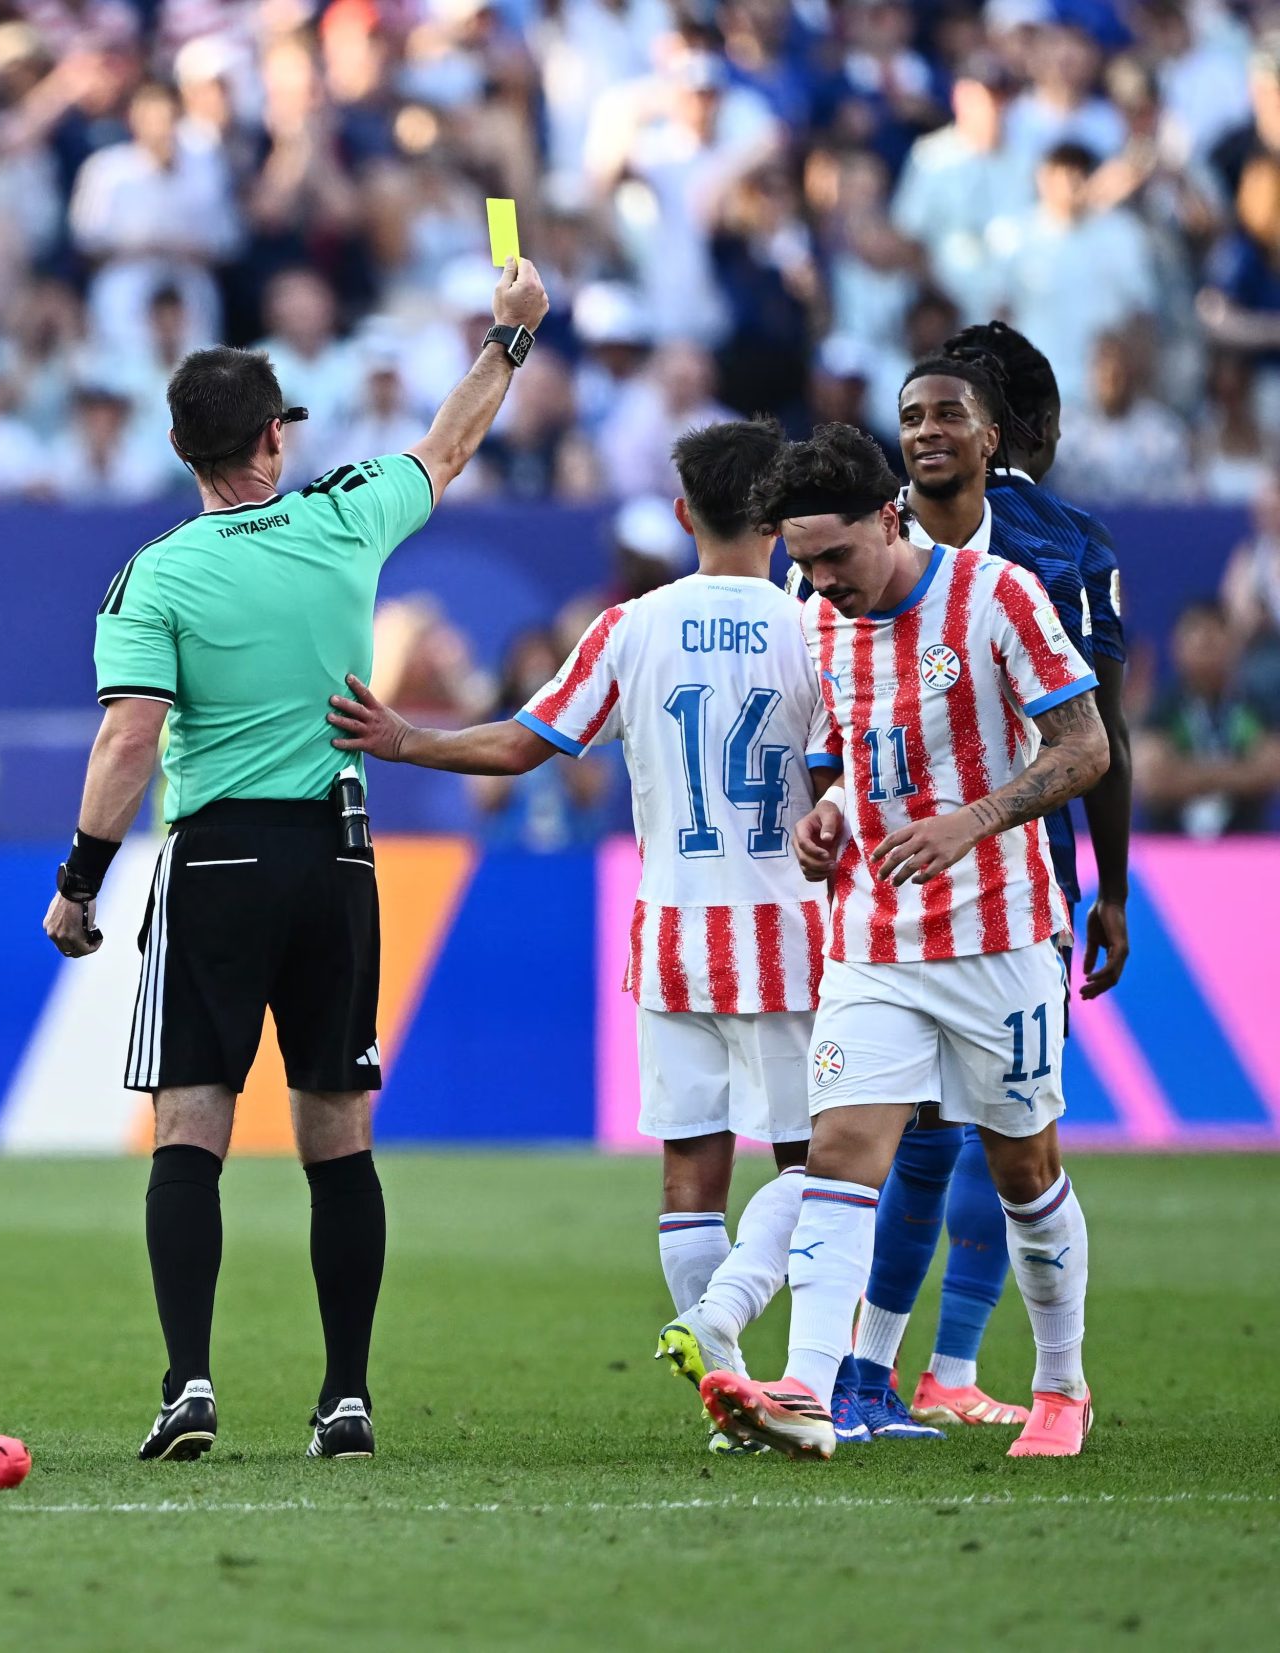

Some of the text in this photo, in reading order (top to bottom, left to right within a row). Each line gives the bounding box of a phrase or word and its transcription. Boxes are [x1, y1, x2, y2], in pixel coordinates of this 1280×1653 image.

[216, 513, 291, 539] TANTASHEV
[681, 617, 769, 655] CUBAS
[663, 683, 795, 860] 14
[862, 724, 919, 804] 11
[1002, 1002, 1051, 1083] 11
